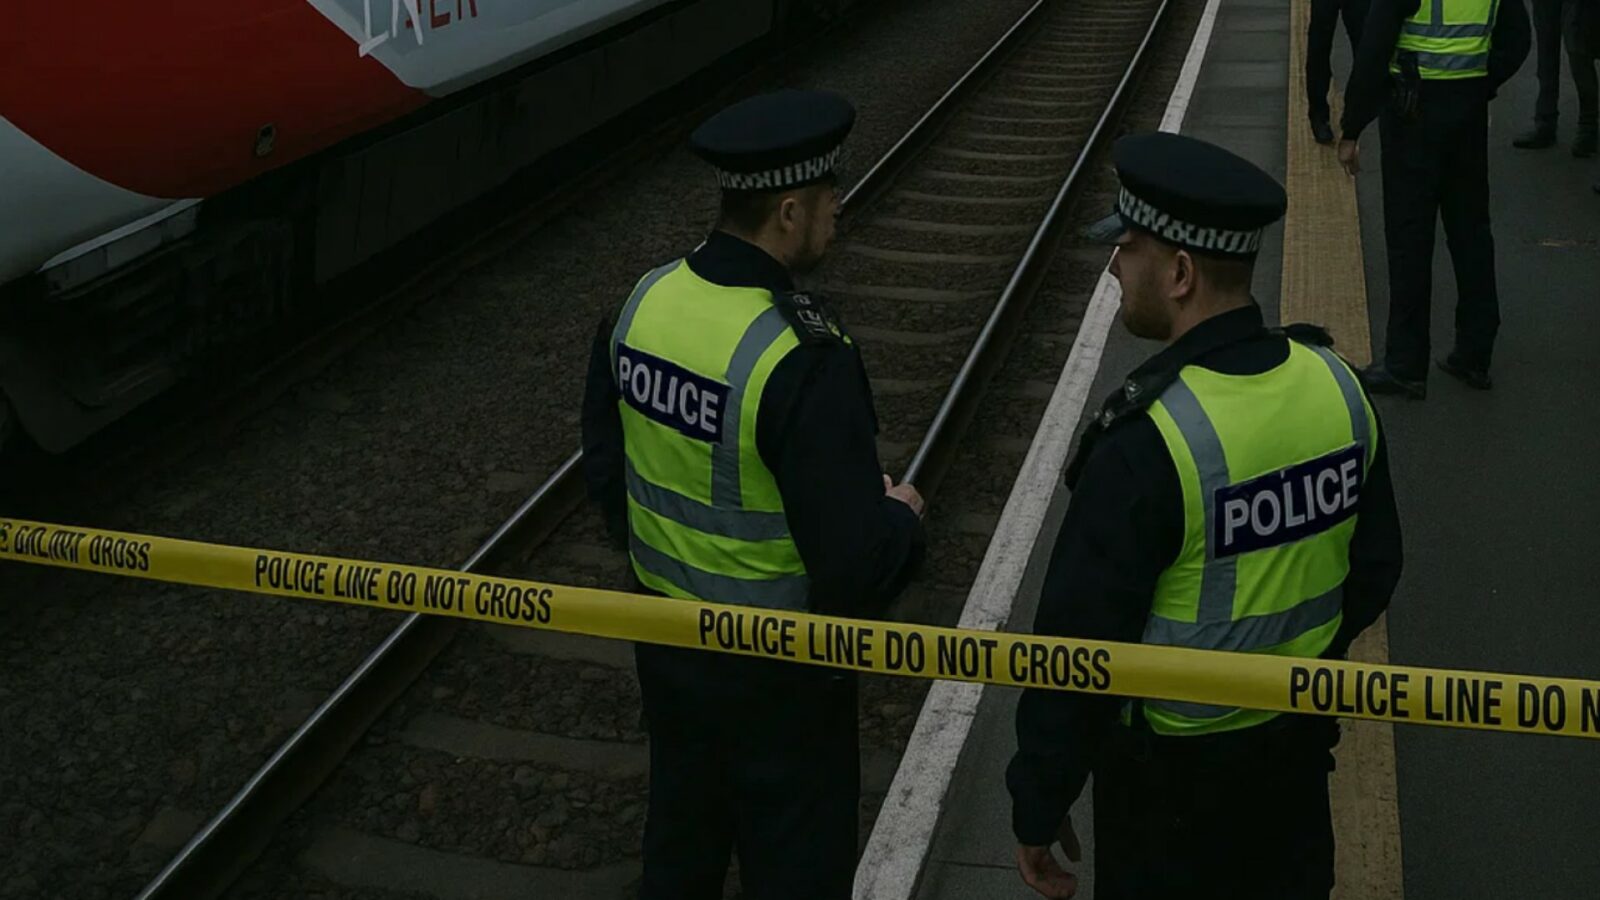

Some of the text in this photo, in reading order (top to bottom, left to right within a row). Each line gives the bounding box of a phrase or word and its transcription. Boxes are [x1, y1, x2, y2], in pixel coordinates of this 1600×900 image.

[618, 355, 720, 435] POLICE
[1223, 457, 1360, 547] POLICE
[255, 554, 328, 595] POLICE
[334, 564, 382, 601] LINE
[423, 575, 471, 612] NOT
[475, 581, 553, 624] CROSS
[699, 608, 1112, 691] POLICE LINE DO NOT CROSS
[1290, 666, 1410, 718] POLICE
[1425, 676, 1503, 725] LINE
[1518, 682, 1566, 731] DO
